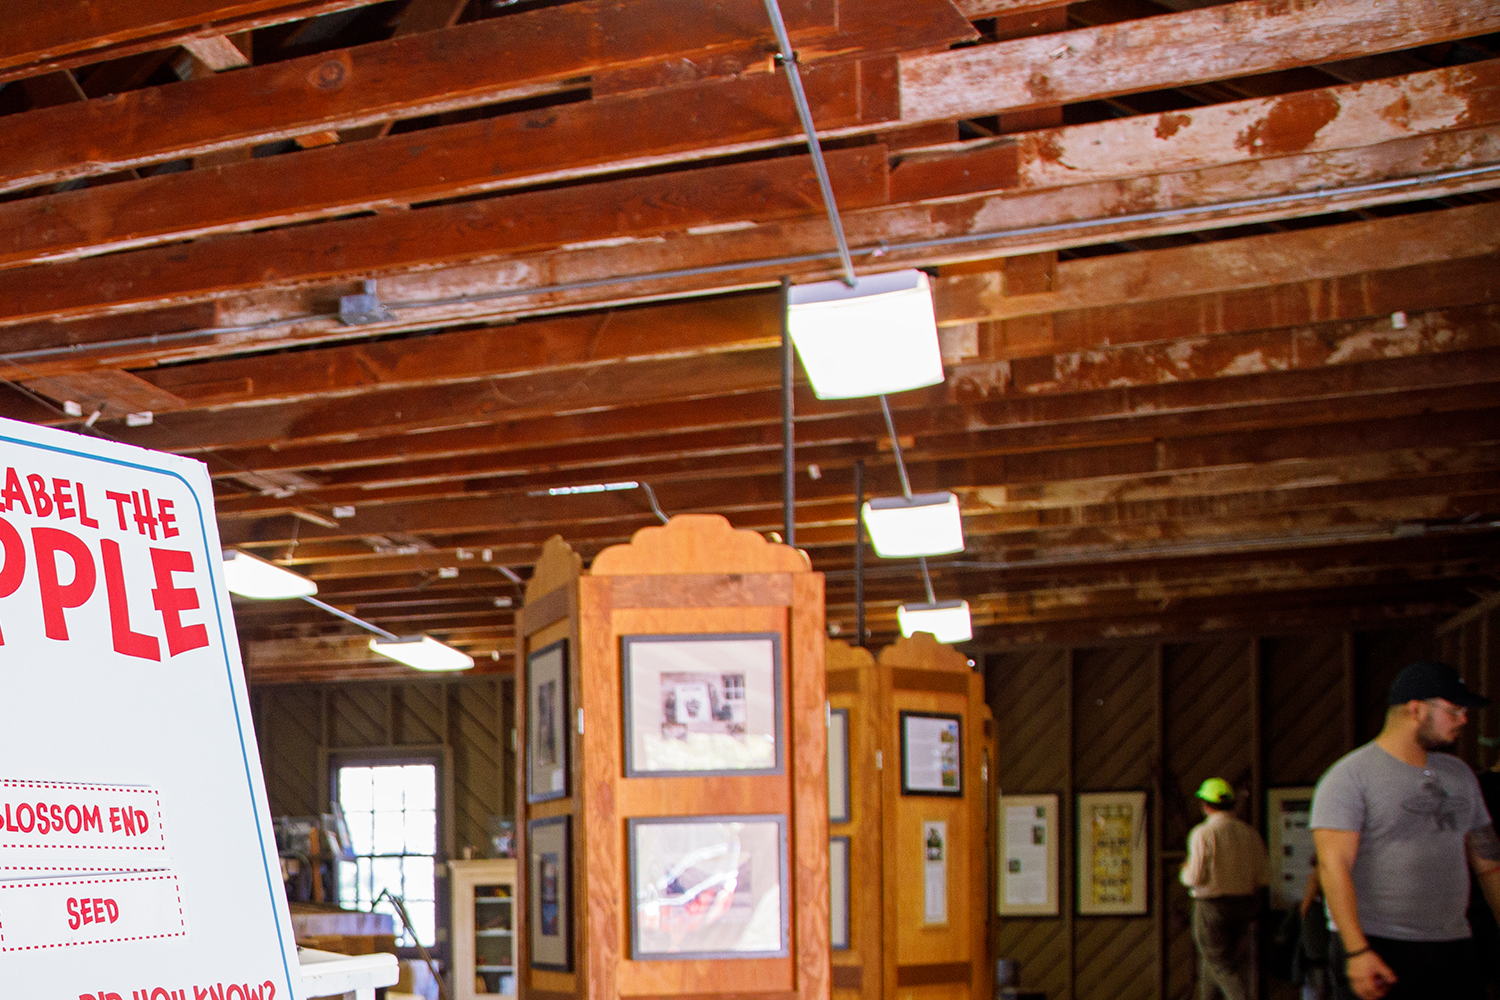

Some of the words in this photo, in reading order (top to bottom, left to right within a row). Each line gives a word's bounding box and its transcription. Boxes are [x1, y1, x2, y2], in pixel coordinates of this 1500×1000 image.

[105, 488, 181, 541] THE
[108, 805, 149, 837] END
[66, 897, 120, 931] SEED
